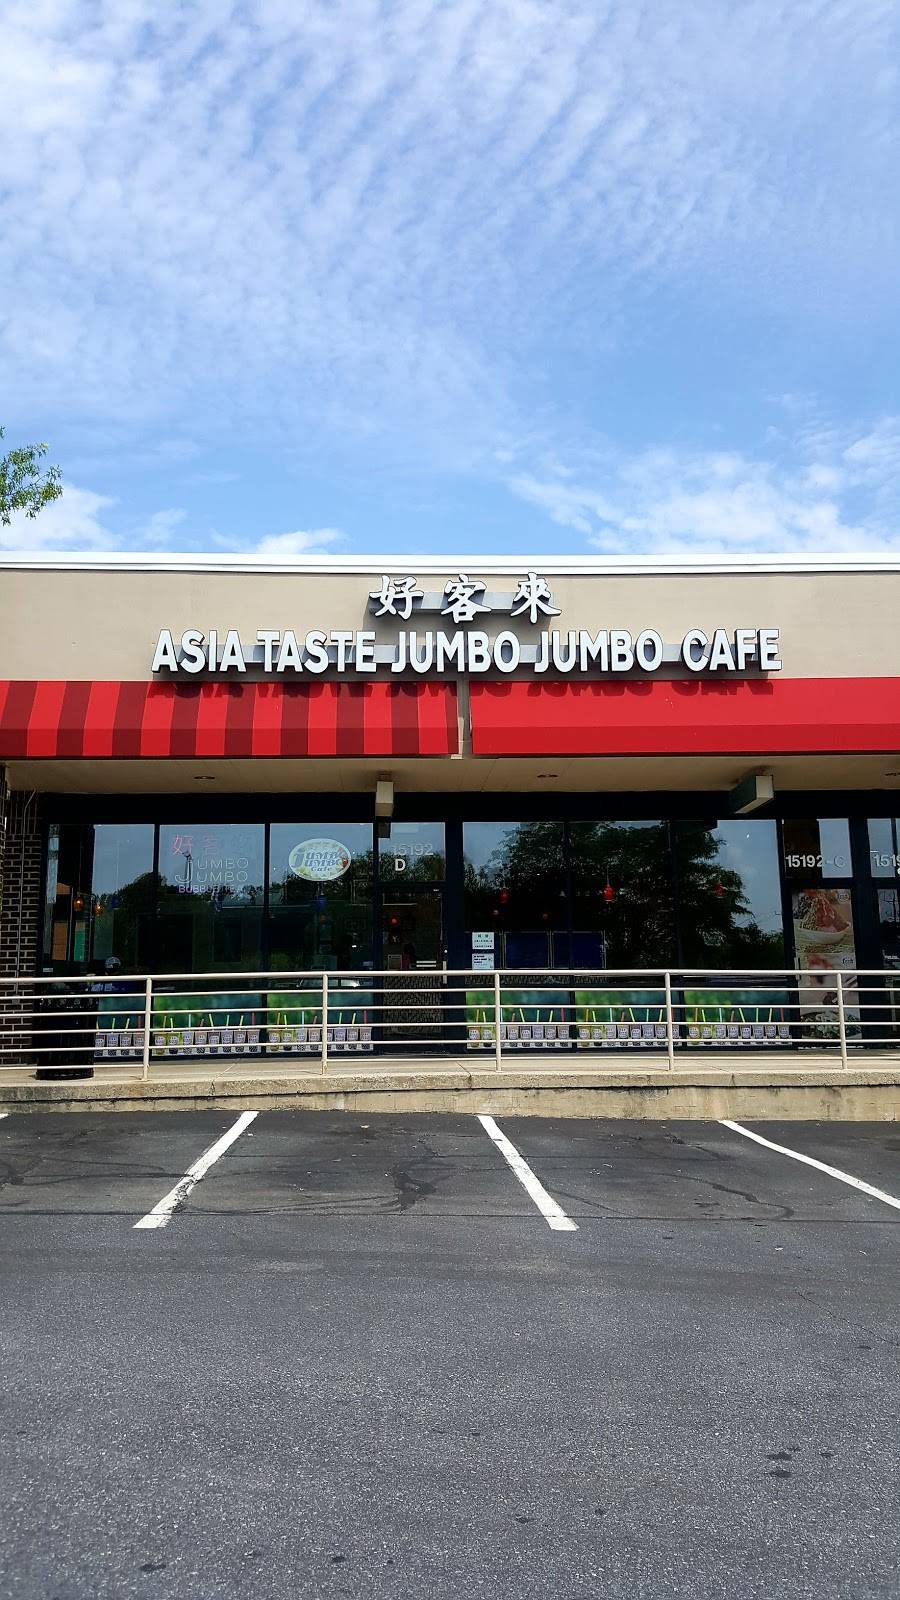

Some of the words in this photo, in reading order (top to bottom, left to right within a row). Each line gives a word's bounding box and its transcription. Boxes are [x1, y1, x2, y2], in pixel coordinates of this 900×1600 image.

[369, 572, 562, 624] 好客來
[152, 629, 247, 674] ASIA
[256, 629, 377, 674] TASTE
[391, 629, 521, 674] JUMBO
[534, 628, 664, 673] JUMBO
[682, 628, 783, 672] CAFE
[394, 858, 406, 871] D
